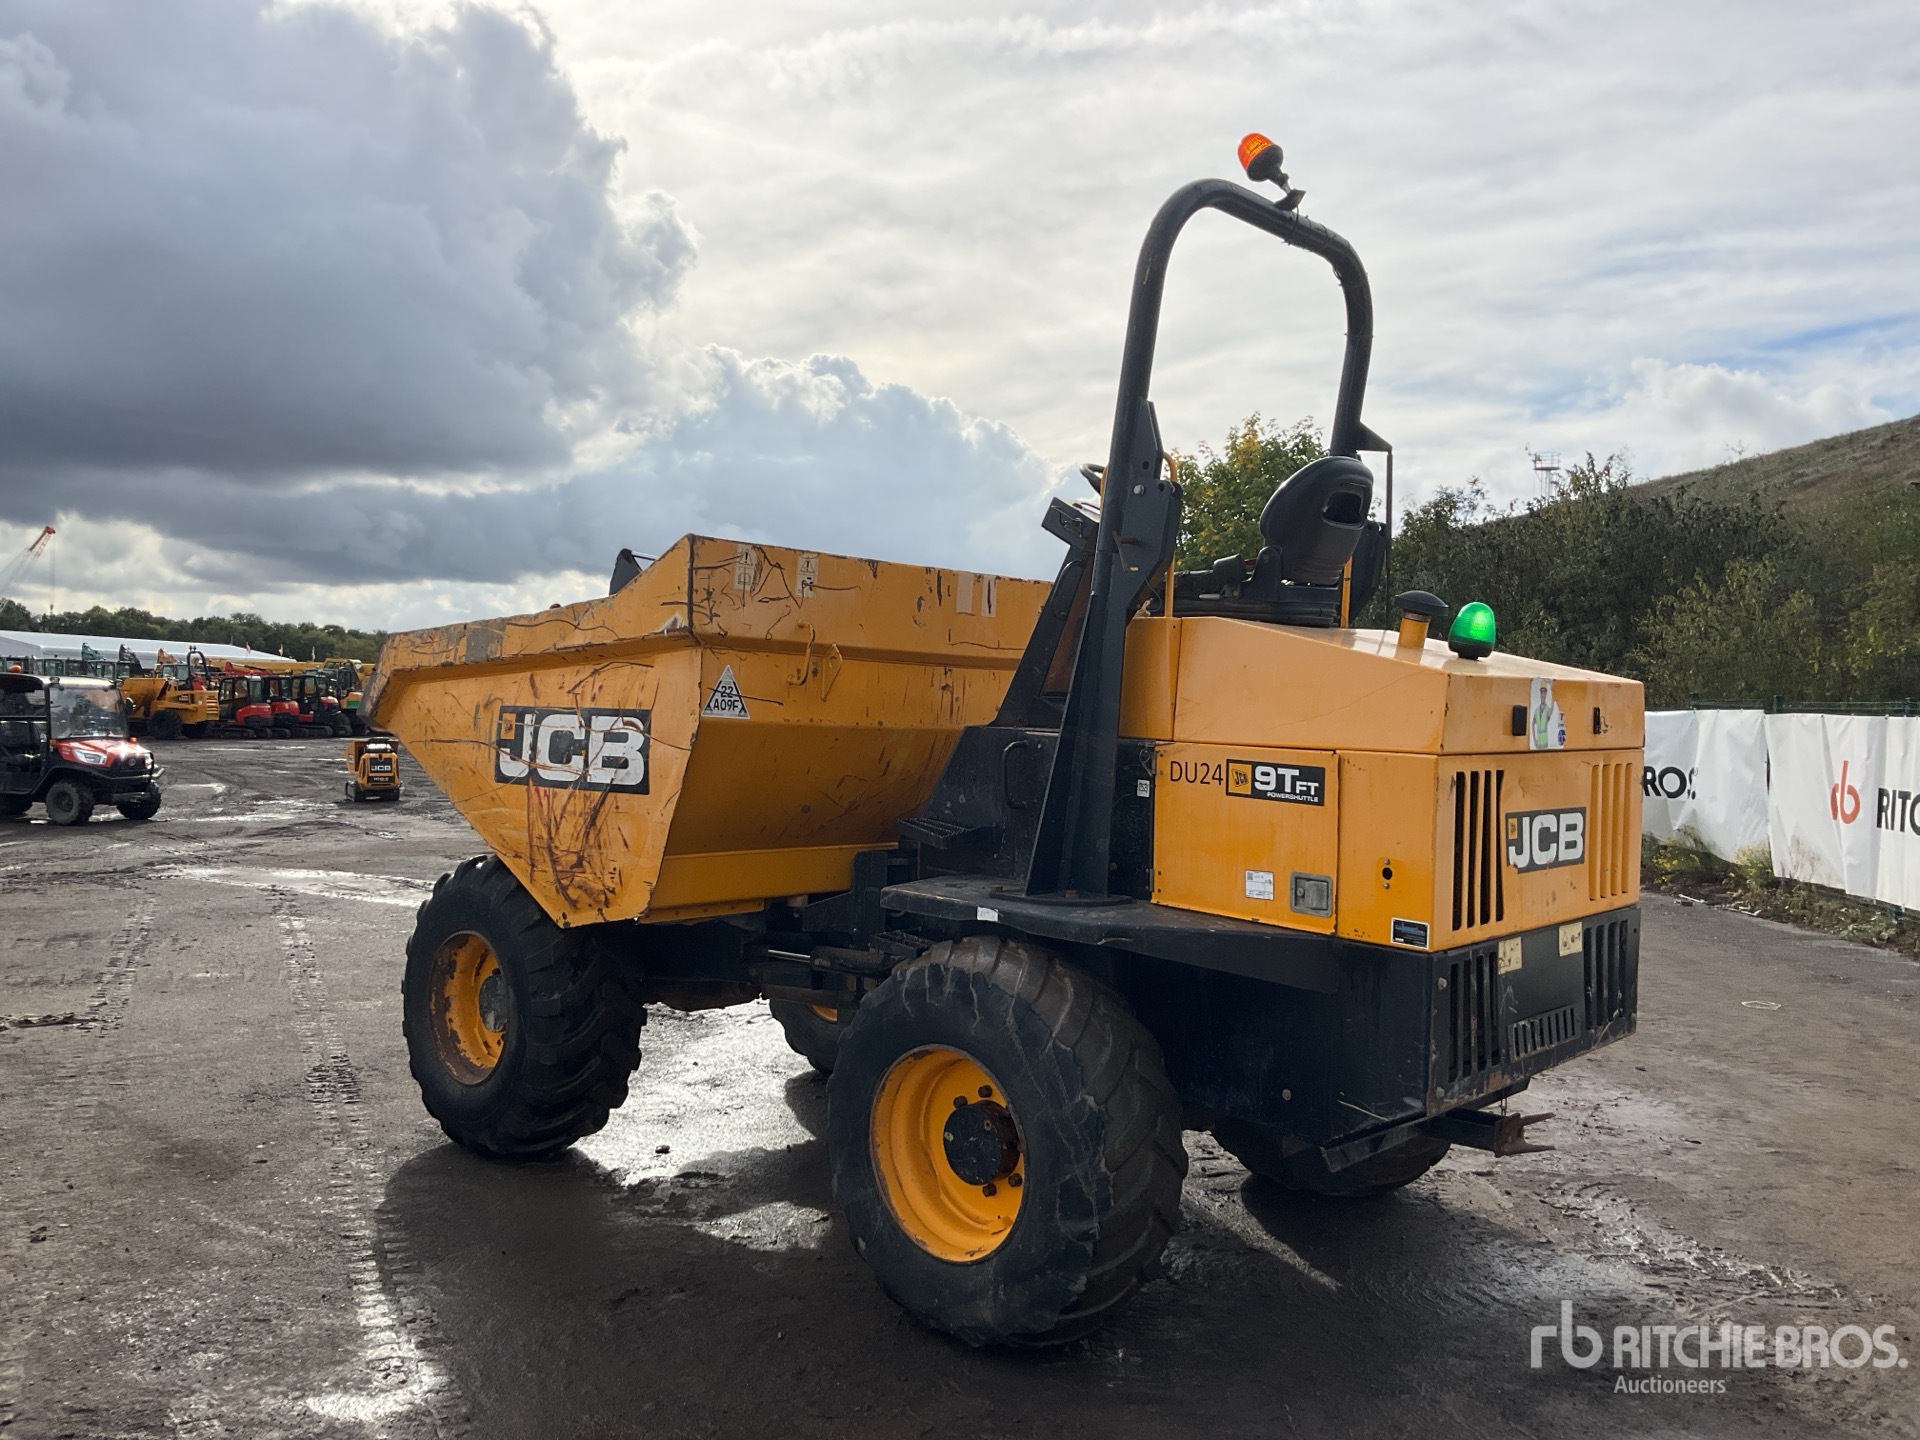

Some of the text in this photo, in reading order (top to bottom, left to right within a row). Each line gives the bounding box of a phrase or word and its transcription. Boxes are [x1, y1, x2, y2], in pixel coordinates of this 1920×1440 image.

[721, 686, 734, 698] 22
[713, 698, 740, 711] A09F
[499, 713, 645, 786] JCB
[1170, 760, 1224, 785] DU24
[1231, 768, 1250, 788] JCB
[1266, 791, 1319, 803] POWERSHUTTLE
[1508, 812, 1584, 869] JCB
